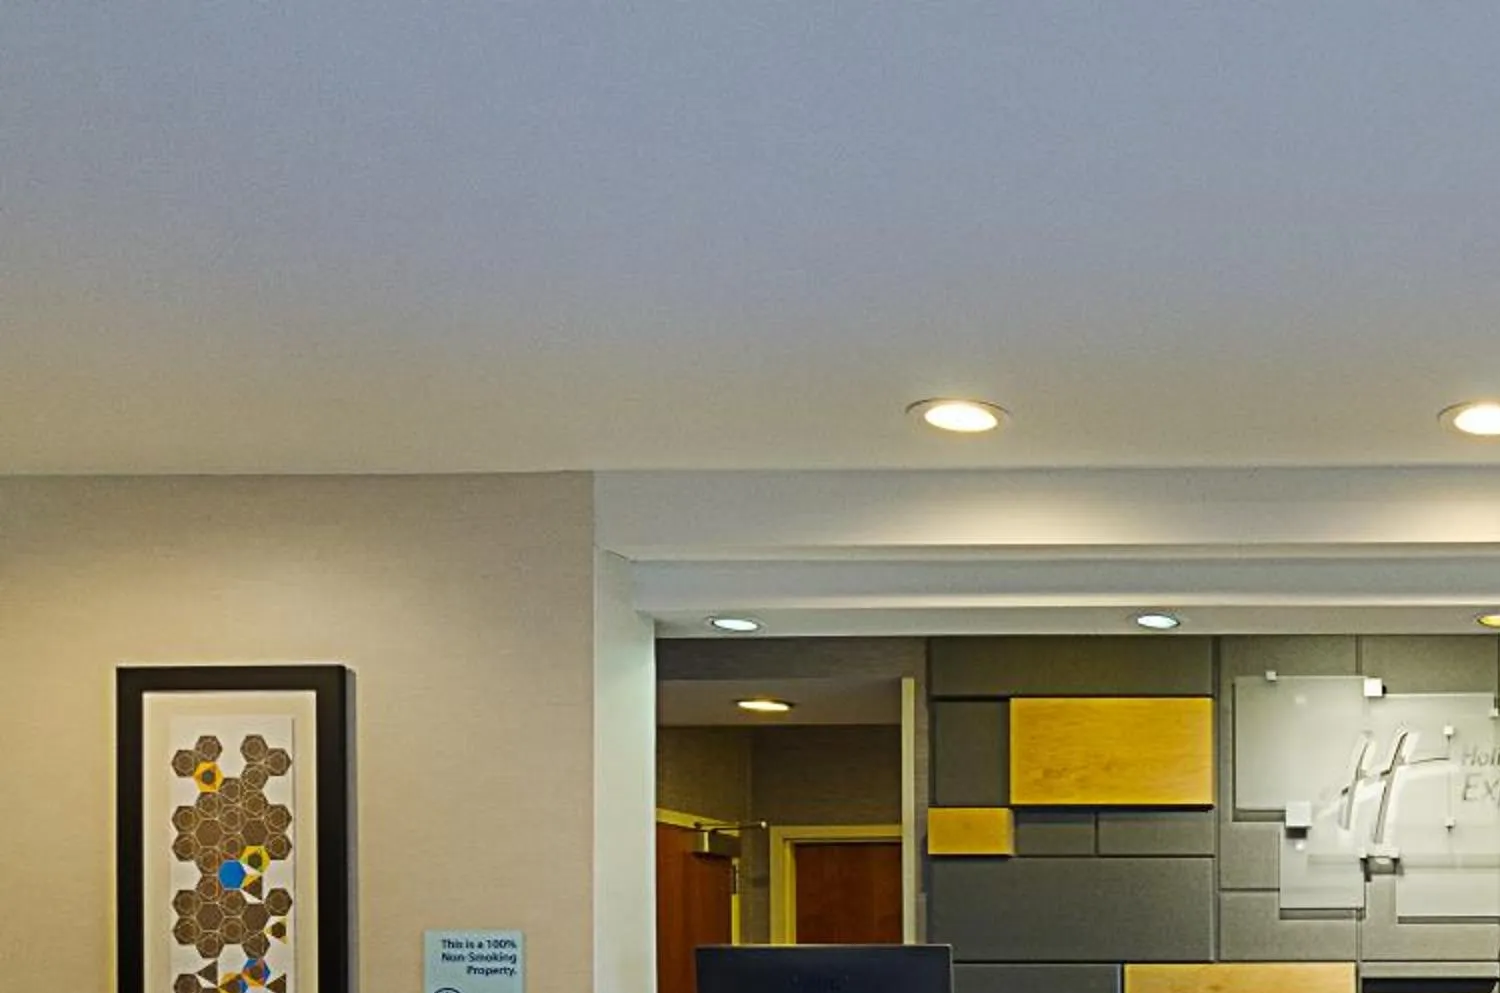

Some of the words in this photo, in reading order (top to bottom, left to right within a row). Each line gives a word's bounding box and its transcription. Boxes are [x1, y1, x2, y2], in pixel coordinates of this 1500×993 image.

[441, 939, 463, 949] This
[465, 939, 475, 949] is
[485, 939, 517, 949] 100%
